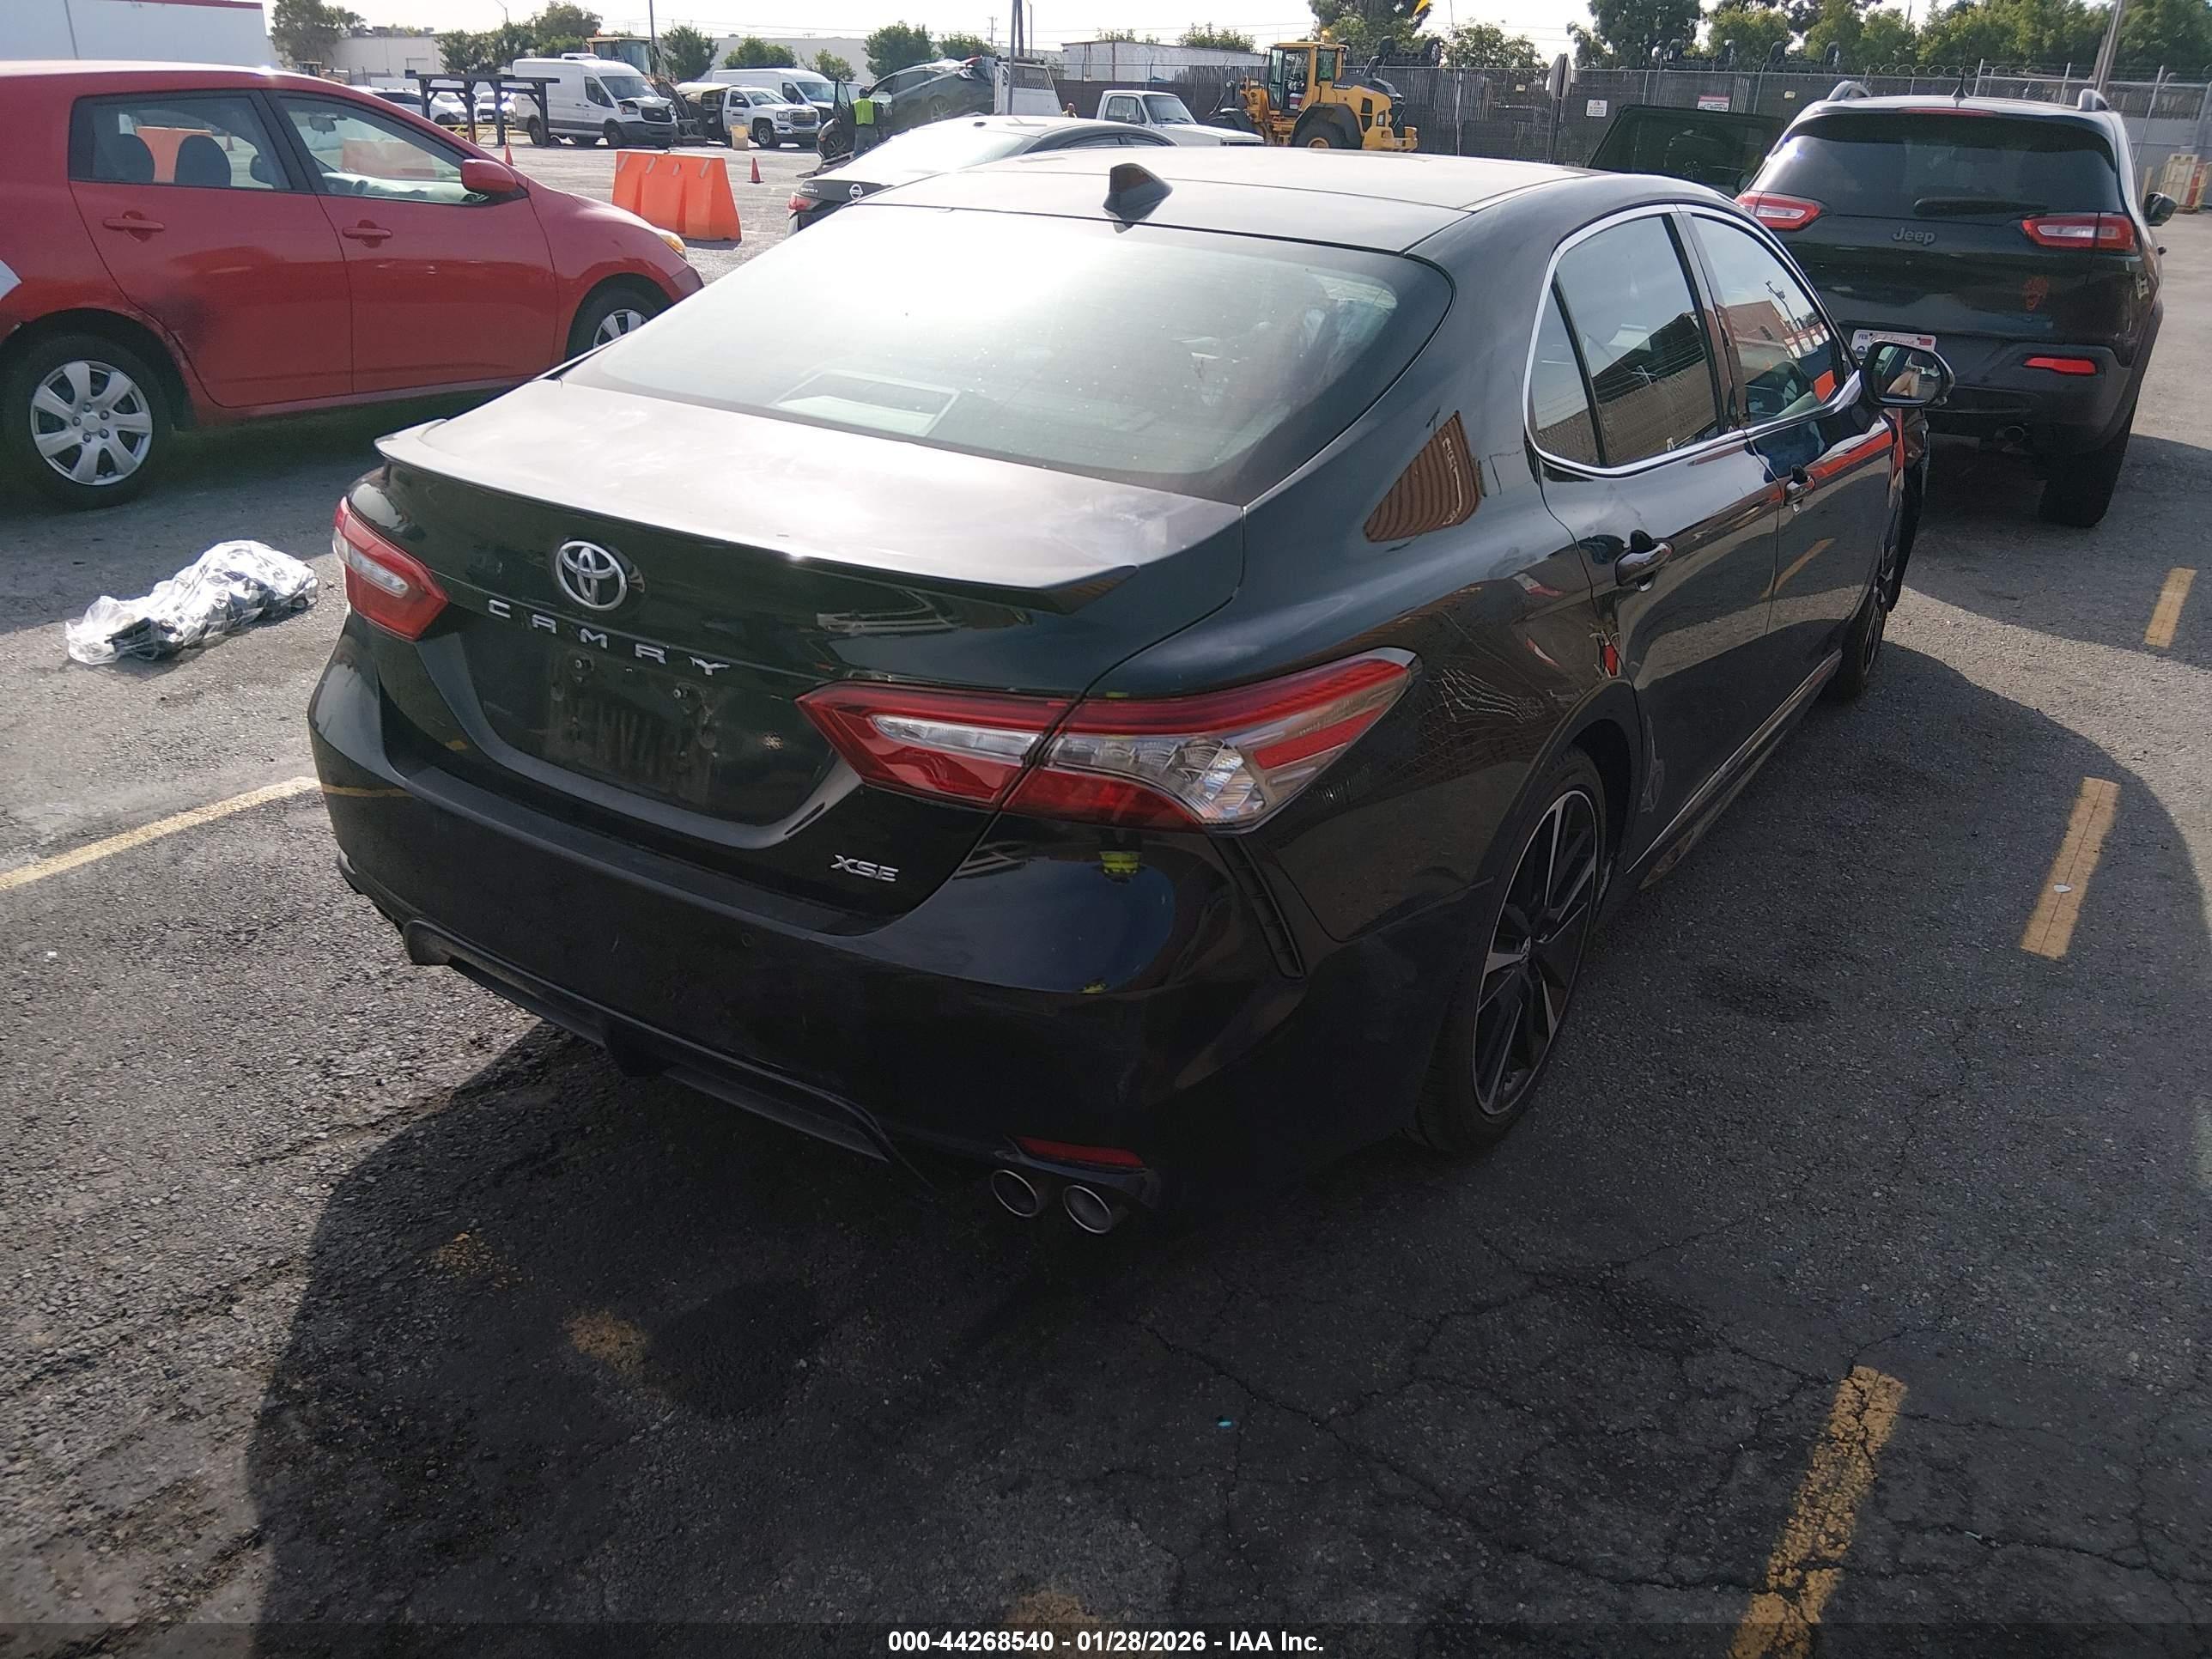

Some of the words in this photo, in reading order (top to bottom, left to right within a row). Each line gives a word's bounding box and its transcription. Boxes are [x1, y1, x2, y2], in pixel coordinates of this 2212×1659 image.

[1892, 227, 1936, 246] Jeep
[488, 599, 730, 677] CAMRY
[830, 854, 900, 883] XSE
